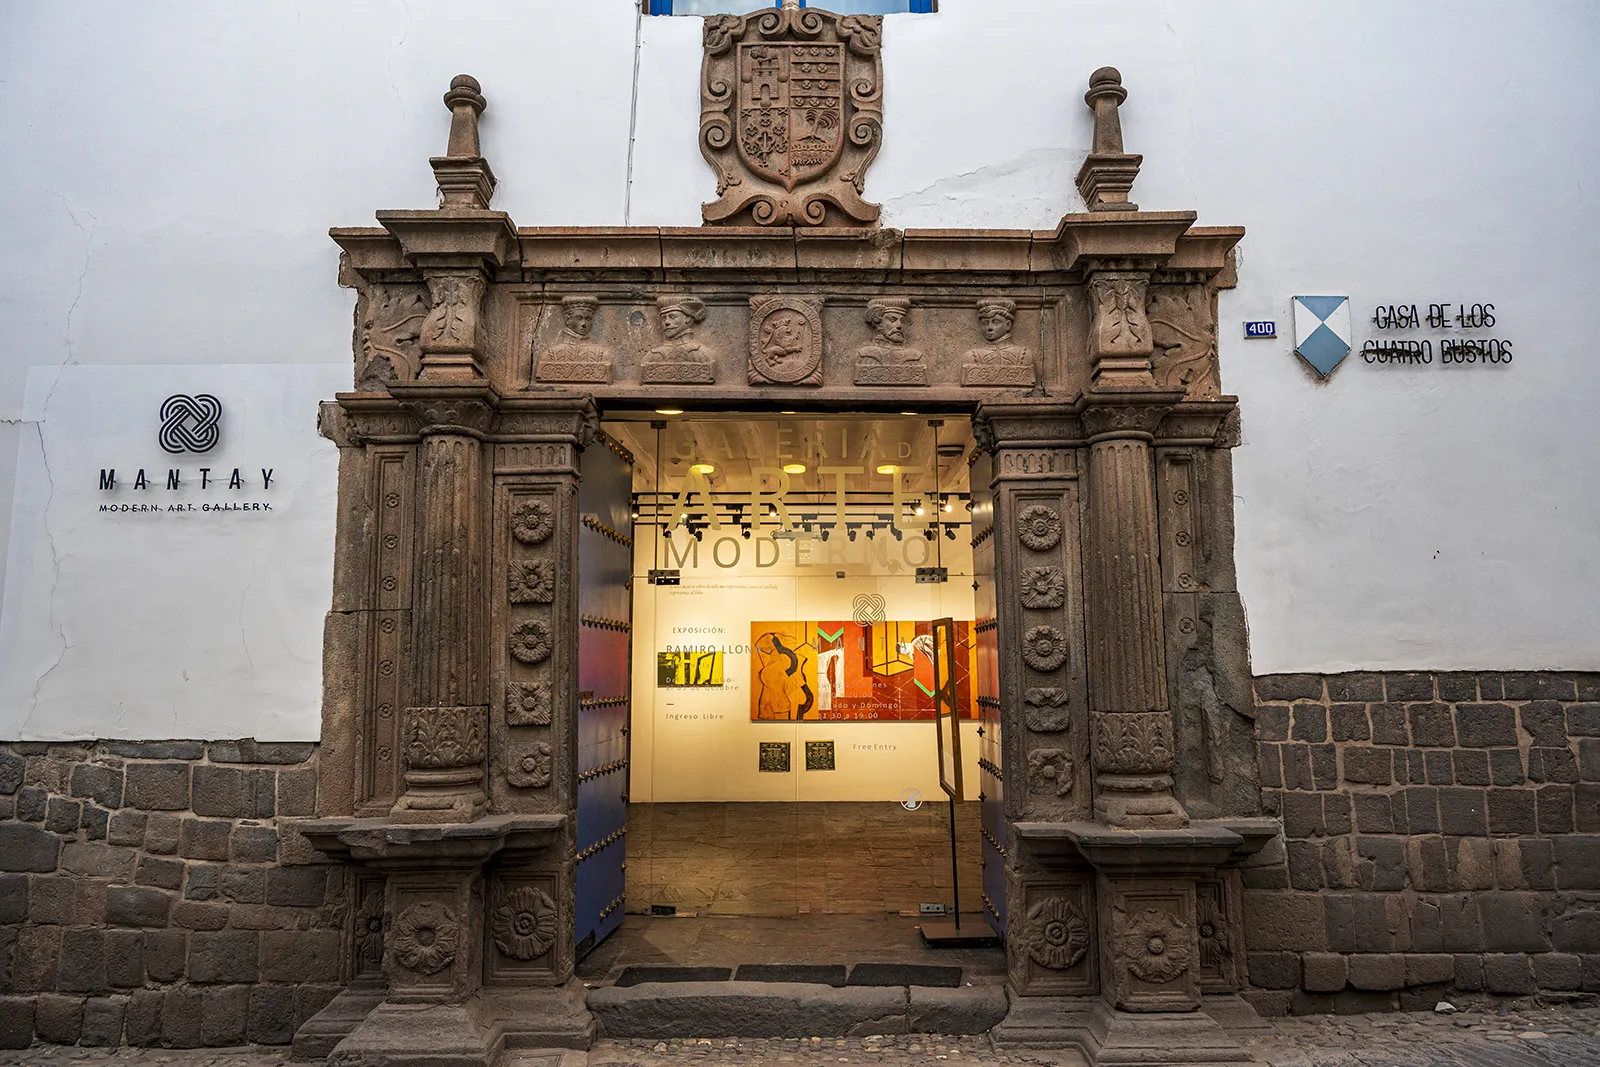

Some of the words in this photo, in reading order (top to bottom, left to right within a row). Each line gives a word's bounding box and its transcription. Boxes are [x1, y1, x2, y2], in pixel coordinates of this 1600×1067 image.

[1375, 304, 1420, 330] CASA
[1428, 303, 1452, 329] DE
[1460, 303, 1496, 329] LOS
[1249, 322, 1274, 335] 400
[1362, 339, 1433, 365] CUATRO
[1440, 338, 1513, 364] BUSTOS
[99, 468, 274, 490] MANTAY
[666, 466, 929, 531] ARTE
[99, 503, 159, 513] MODERN
[167, 503, 193, 513] ART
[202, 502, 272, 512] GALLERY
[663, 535, 931, 569] MODERNO
[672, 626, 726, 634] EXPOSICIÓN:
[666, 645, 716, 654] RAMIRO
[721, 645, 761, 654] LLONA
[812, 636, 927, 651] MANTAY
[860, 702, 898, 710] Domingo
[666, 713, 698, 721] Ingreso
[852, 743, 872, 751] Free
[873, 743, 897, 752] Entry
